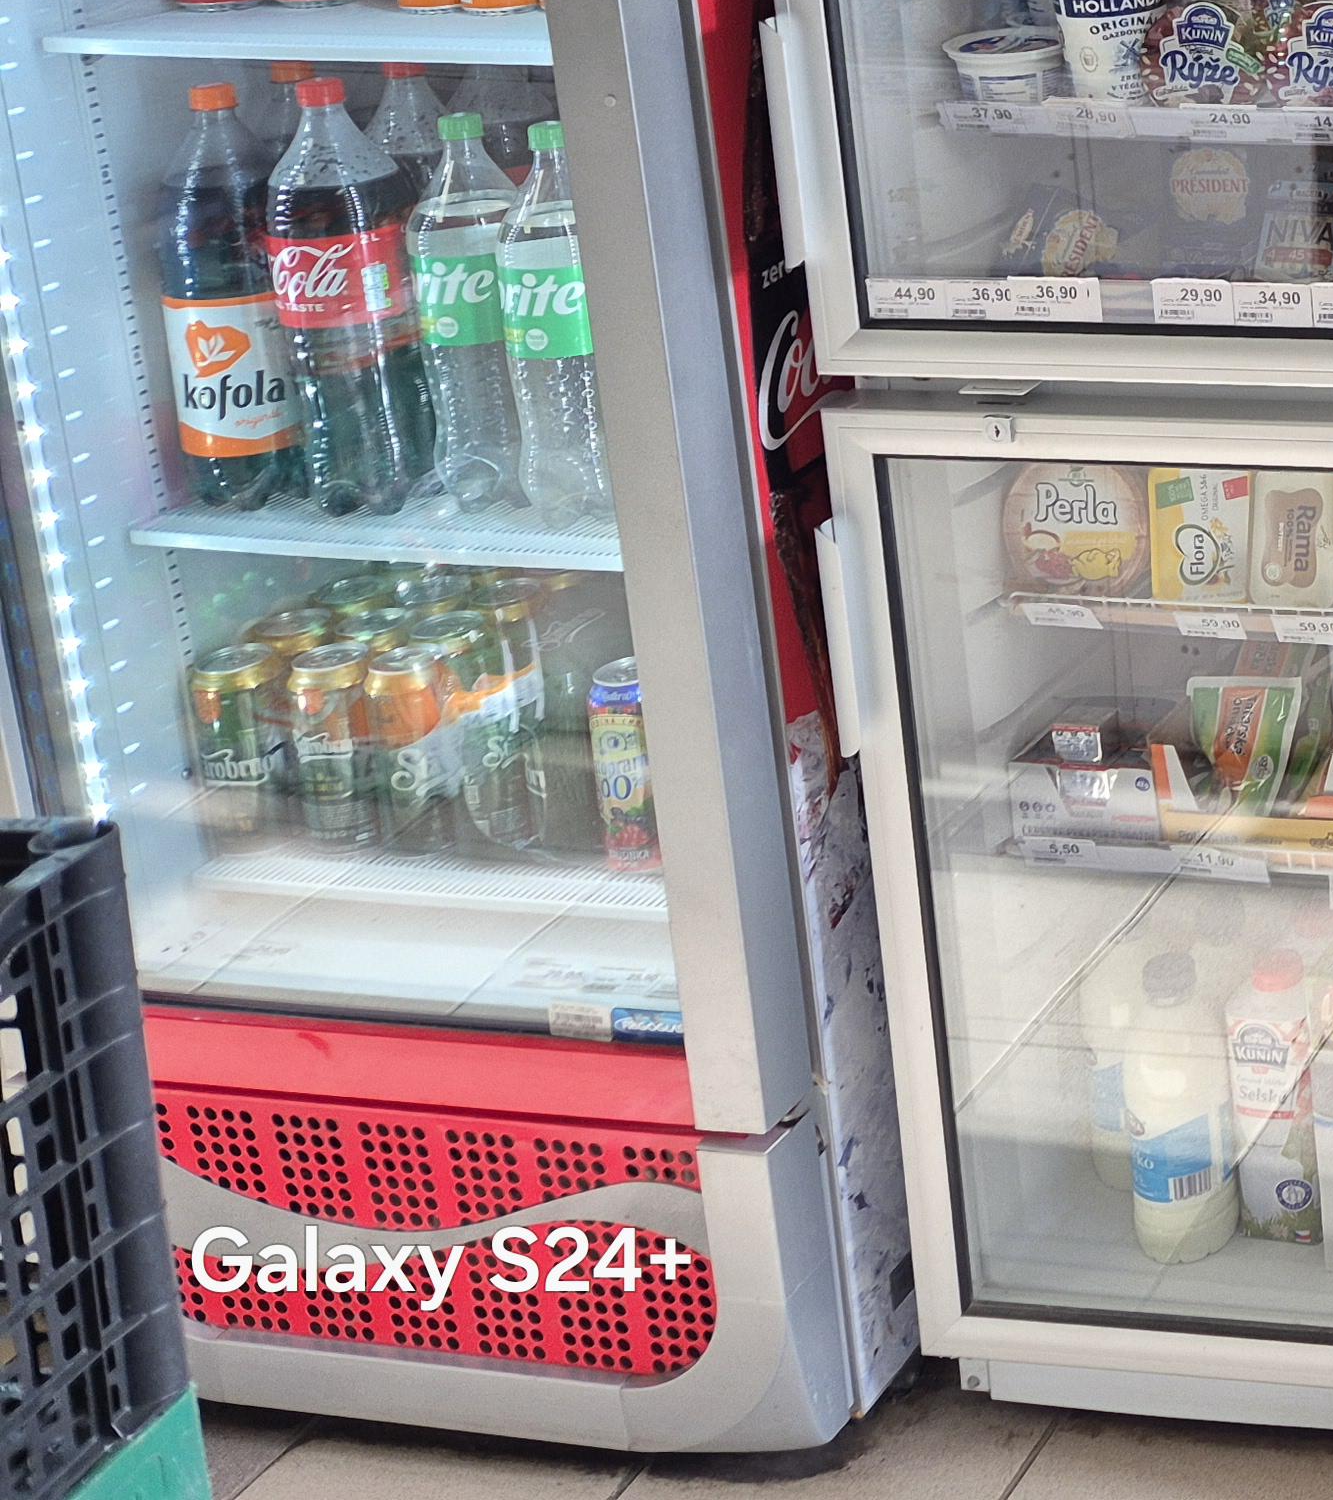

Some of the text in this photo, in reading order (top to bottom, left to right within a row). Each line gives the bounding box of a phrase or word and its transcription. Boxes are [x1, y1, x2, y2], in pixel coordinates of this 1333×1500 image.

[1090, 15, 1157, 35] ORIGINÁ
[1161, 51, 1238, 88] Rýže
[972, 108, 1012, 121] 37,90
[1076, 107, 1117, 123] 28,90
[1209, 112, 1250, 126] 24,90
[414, 260, 494, 304] rite
[502, 269, 586, 318] rite
[894, 287, 935, 303] 44,90
[1036, 285, 1077, 302] 36,90
[1181, 288, 1222, 304] 29,90
[1259, 291, 1300, 307] 34,90
[288, 302, 325, 313] TASTE
[182, 369, 286, 421] kofola
[1035, 482, 1118, 525] Perla
[1294, 505, 1316, 572] Rama
[1190, 534, 1204, 576] Flora
